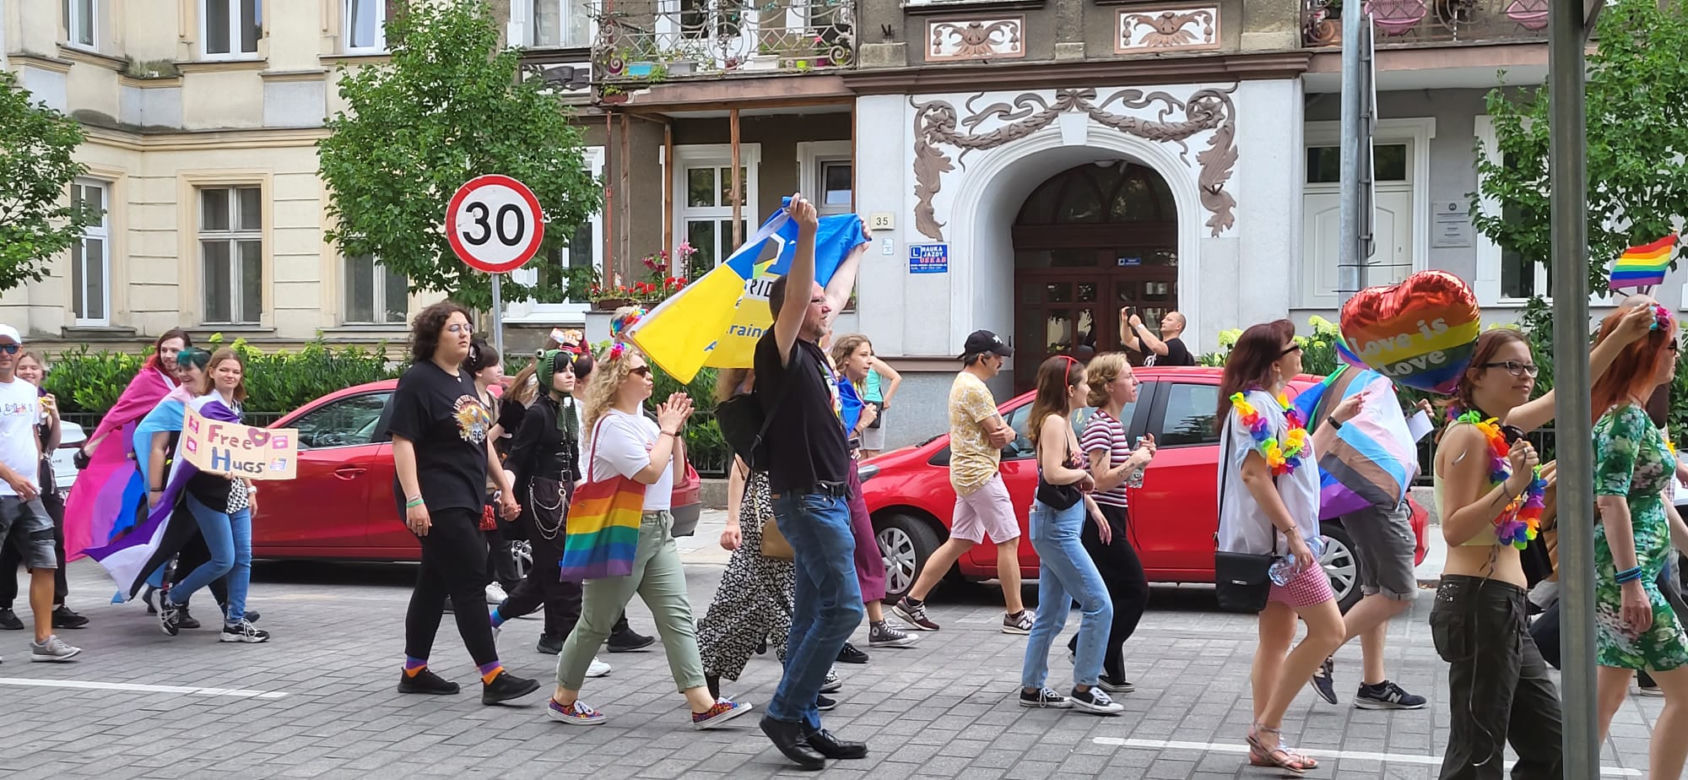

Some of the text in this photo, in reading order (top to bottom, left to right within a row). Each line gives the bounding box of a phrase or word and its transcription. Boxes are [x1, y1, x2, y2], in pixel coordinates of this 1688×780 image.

[463, 202, 525, 246] 30
[876, 216, 889, 226] 35
[749, 279, 773, 297] RID
[1348, 317, 1448, 357] Love is
[1377, 350, 1447, 377] Love
[208, 424, 252, 450] Free
